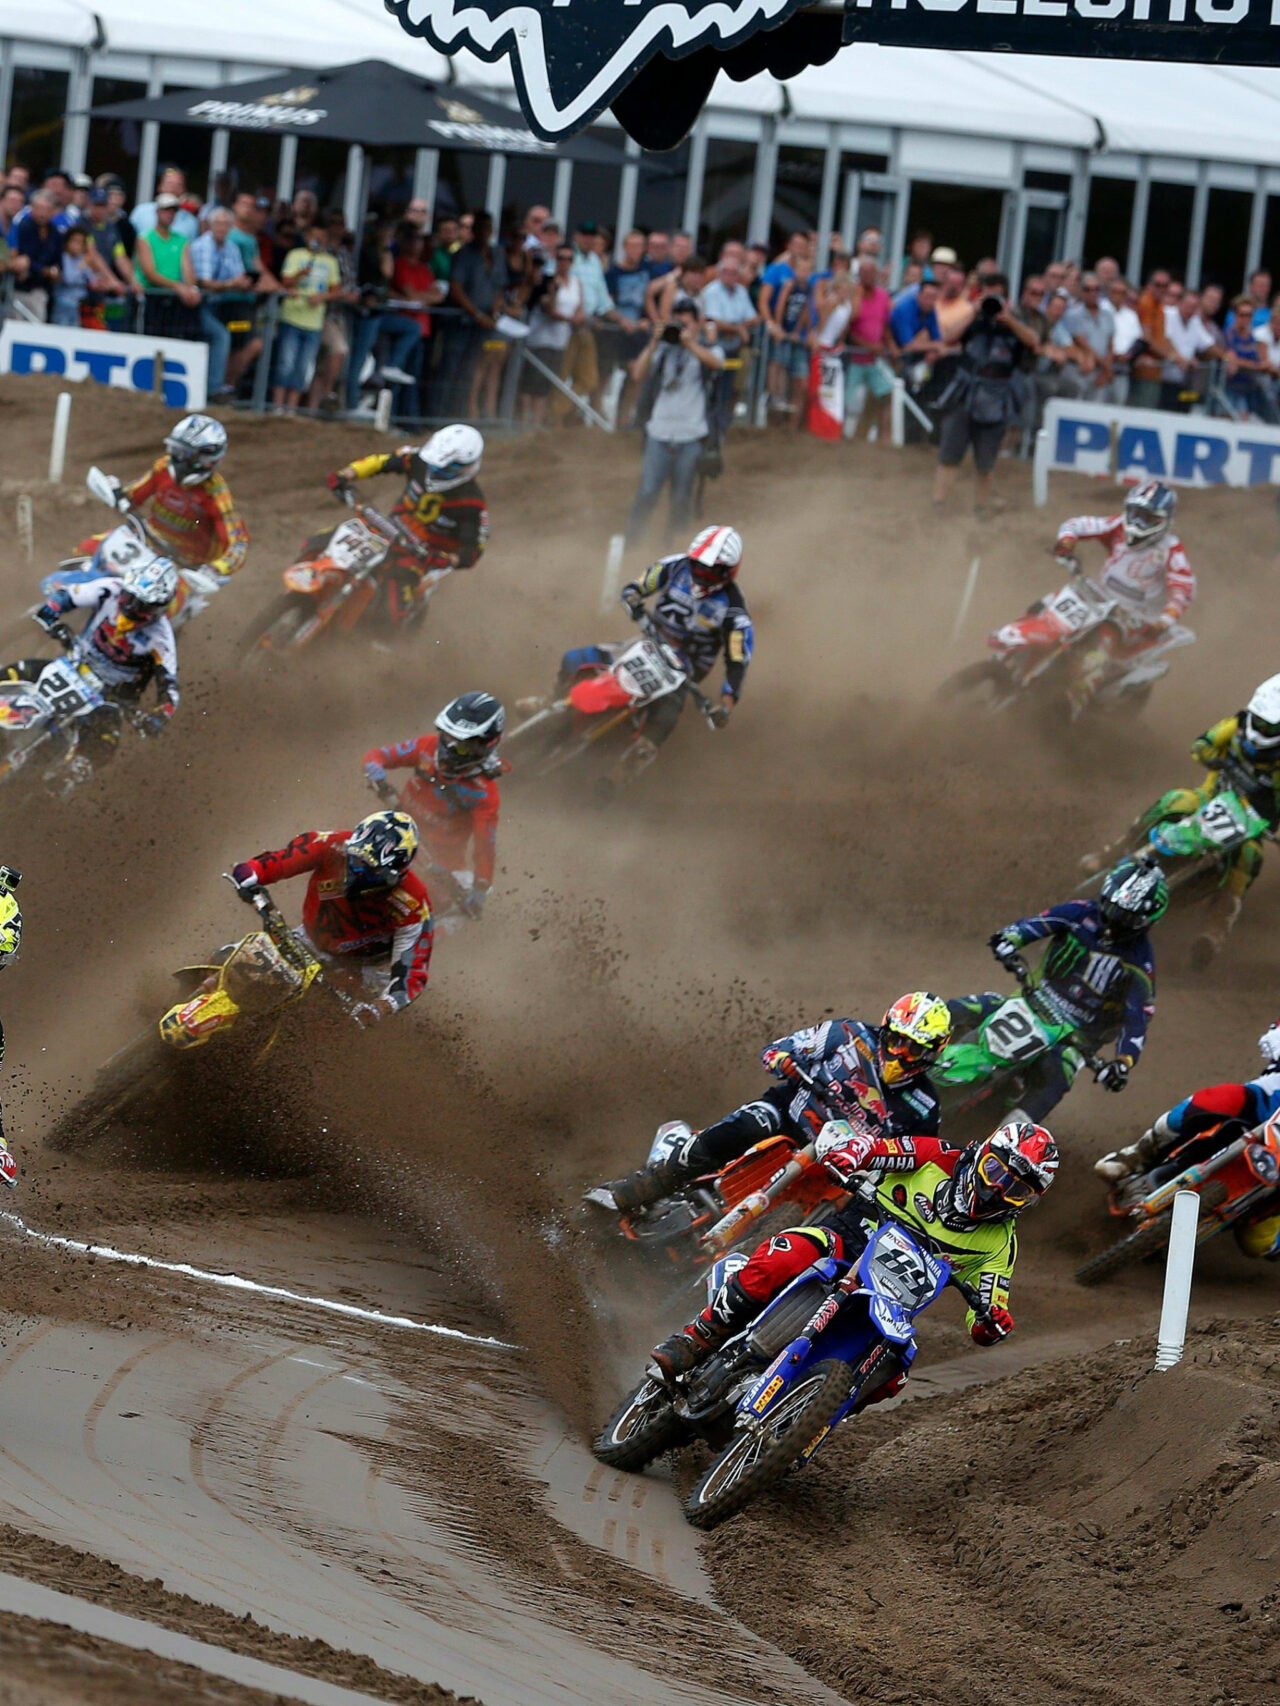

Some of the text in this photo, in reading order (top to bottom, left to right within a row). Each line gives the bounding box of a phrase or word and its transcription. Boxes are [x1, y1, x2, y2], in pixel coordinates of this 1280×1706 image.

[988, 1011, 1046, 1061] 21
[869, 1156, 915, 1170] MAHA
[915, 1194, 935, 1223] Airoh
